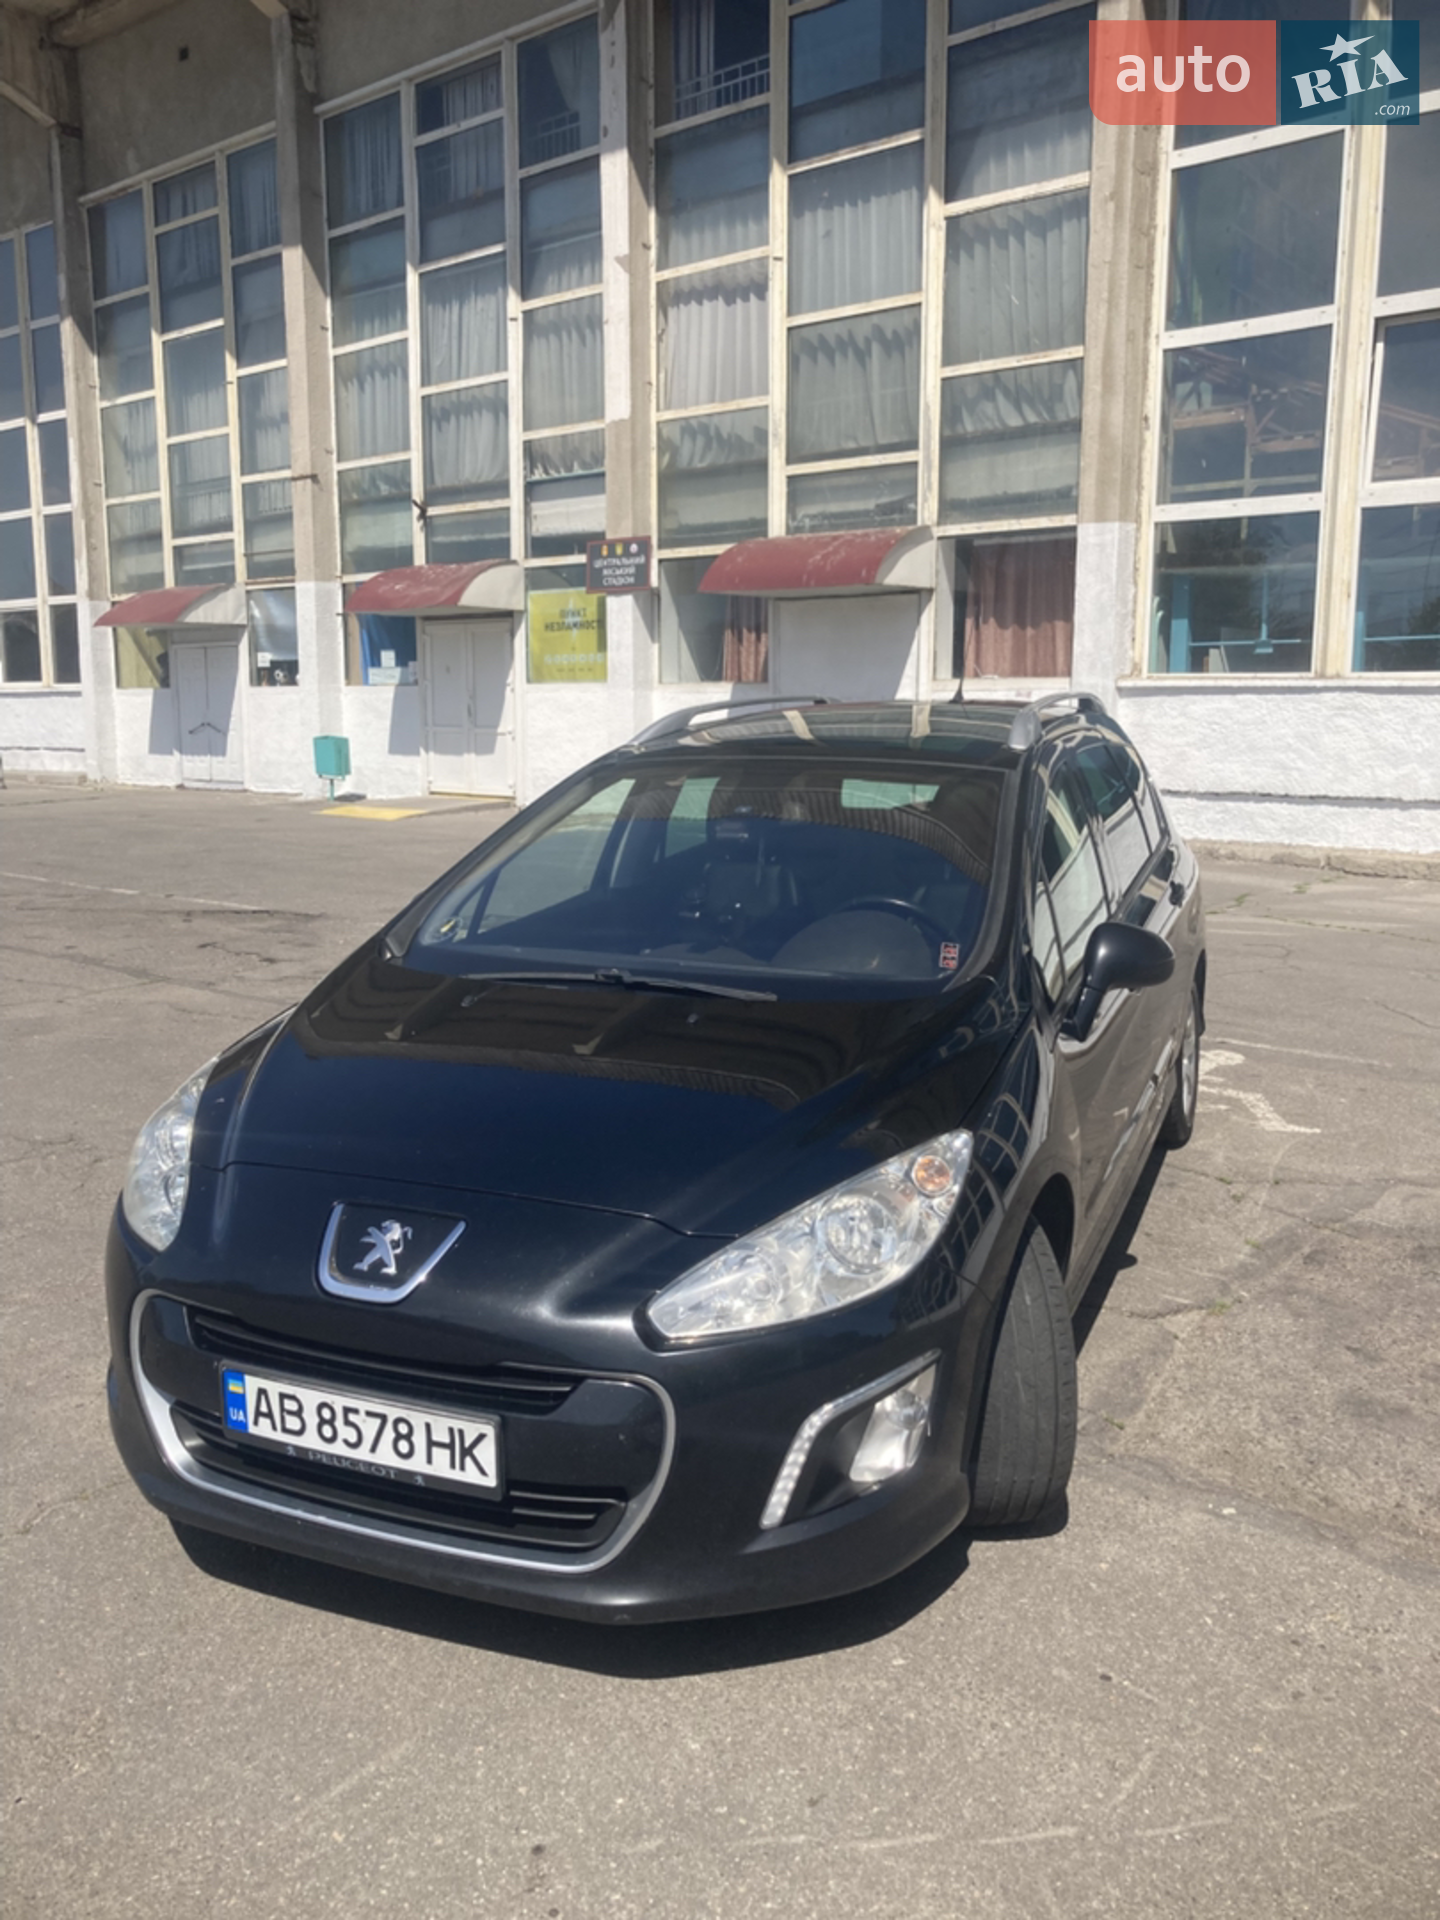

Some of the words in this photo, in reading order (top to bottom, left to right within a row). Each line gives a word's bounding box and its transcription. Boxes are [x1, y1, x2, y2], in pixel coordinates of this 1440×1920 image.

[229, 1406, 246, 1422] UA
[253, 1386, 306, 1437] AB
[316, 1401, 415, 1460] 8578
[424, 1421, 489, 1478] HK
[308, 1451, 399, 1479] PEUGEOT
